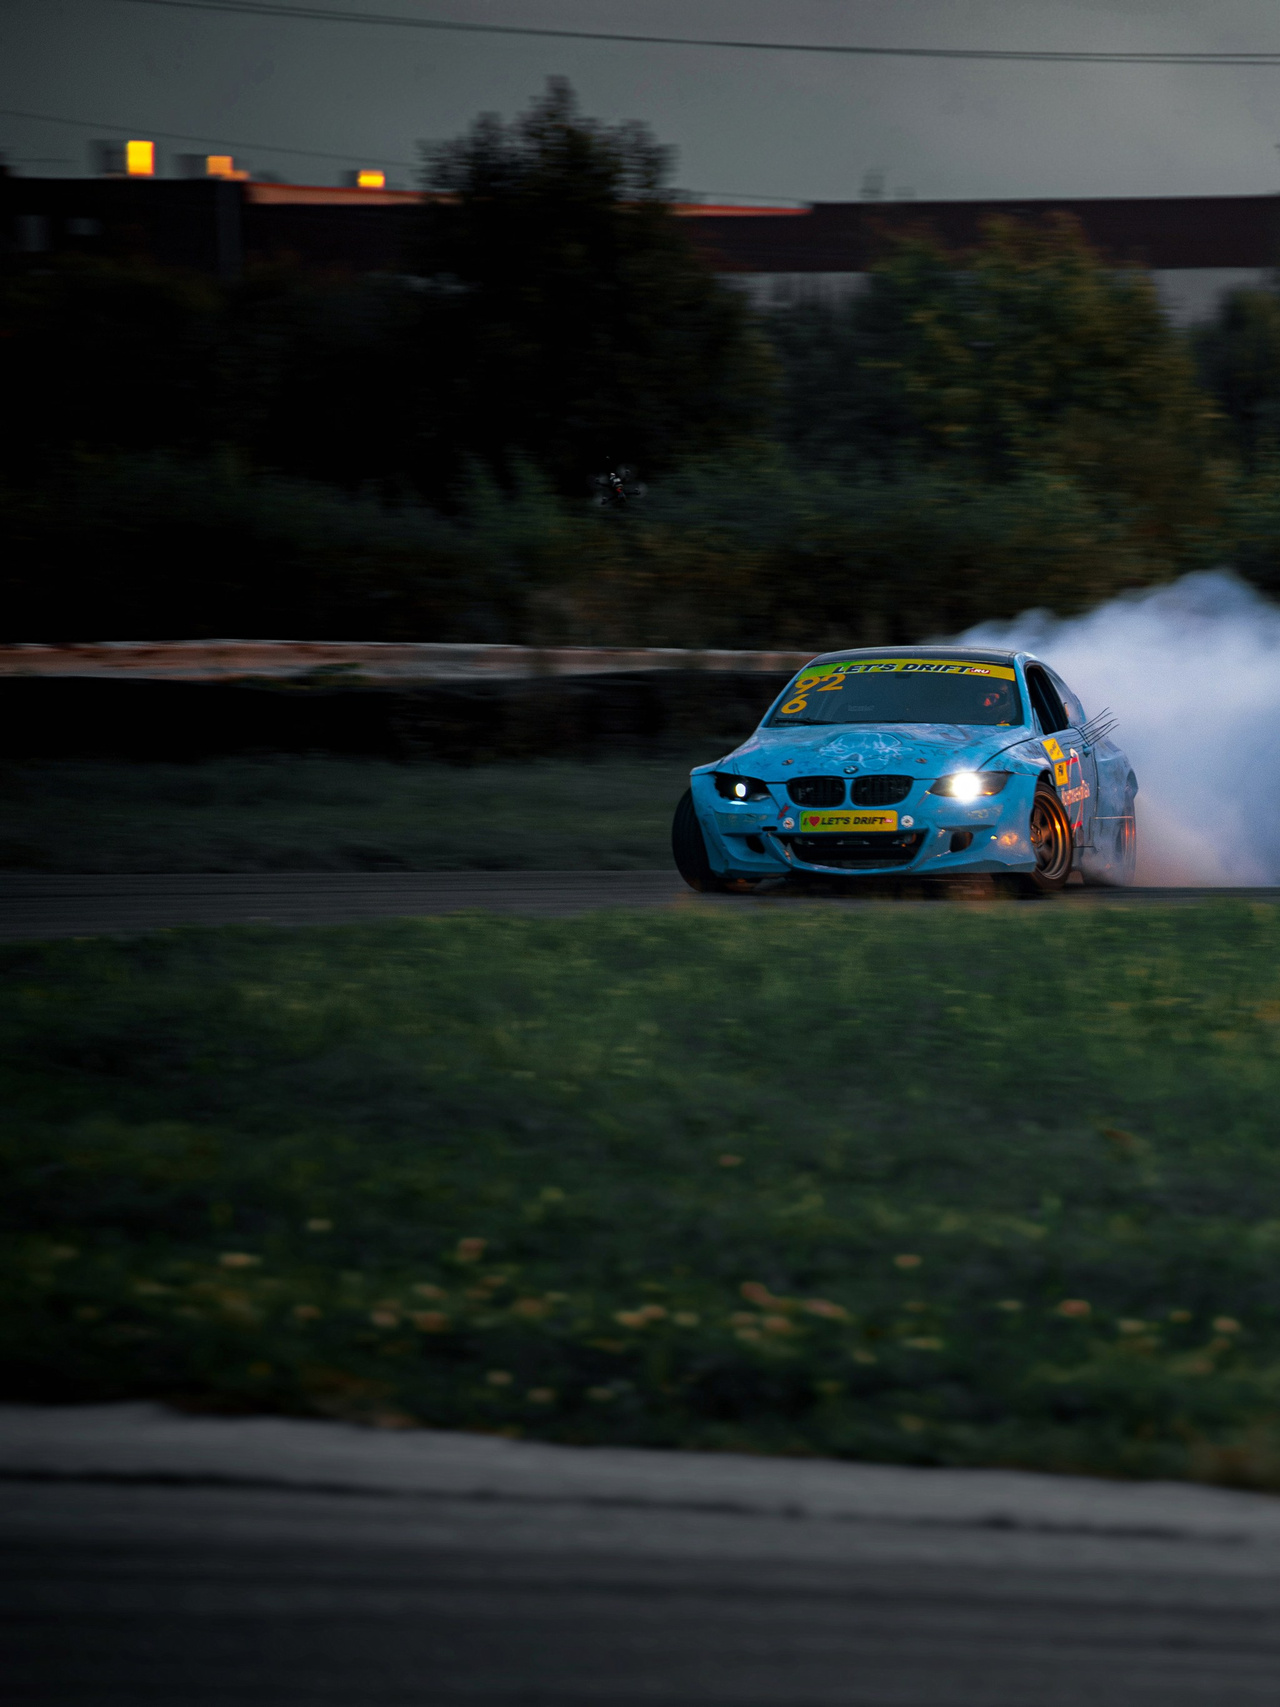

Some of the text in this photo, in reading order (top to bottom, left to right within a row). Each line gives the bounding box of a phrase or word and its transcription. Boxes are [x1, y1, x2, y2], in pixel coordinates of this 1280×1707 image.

[832, 663, 899, 675] LET'S
[793, 674, 846, 695] 92
[780, 693, 810, 714] 6
[803, 817, 807, 826] I
[821, 816, 850, 825] LET'S
